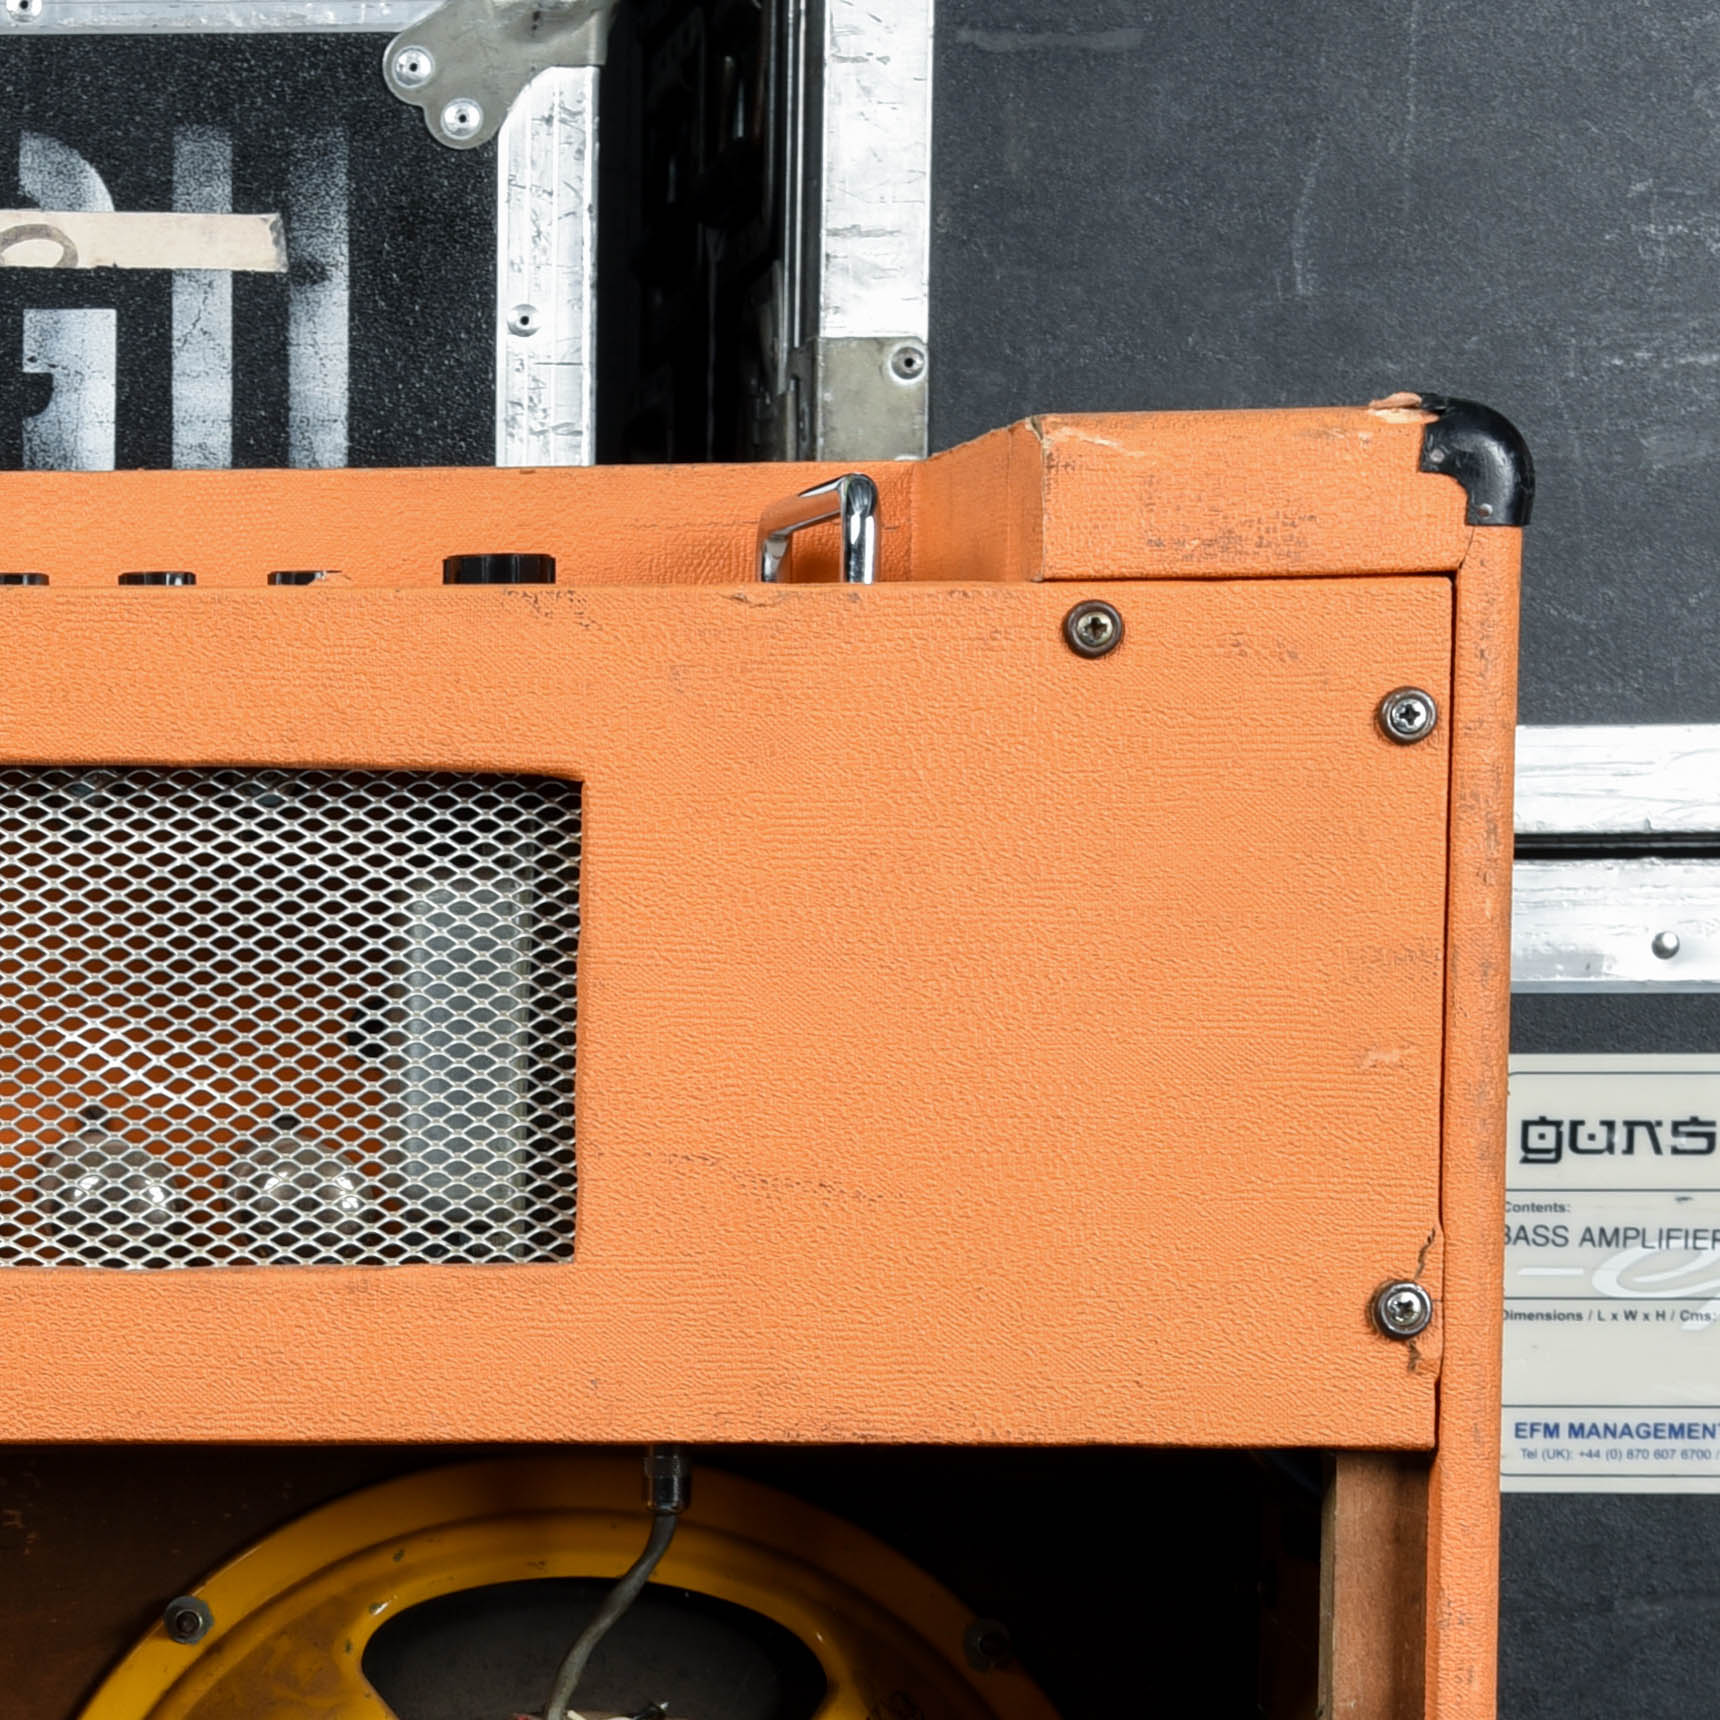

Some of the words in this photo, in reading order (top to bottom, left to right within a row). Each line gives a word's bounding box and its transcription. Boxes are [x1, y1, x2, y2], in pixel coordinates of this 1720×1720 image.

[1504, 1201, 1570, 1213] Contents:
[1579, 1226, 1720, 1250] AMPLIFIER
[1597, 1310, 1605, 1321] L
[1611, 1313, 1618, 1321] x
[1624, 1310, 1637, 1321] W
[1643, 1313, 1650, 1321] x
[1656, 1310, 1666, 1321] H
[1514, 1422, 1560, 1439] EFM
